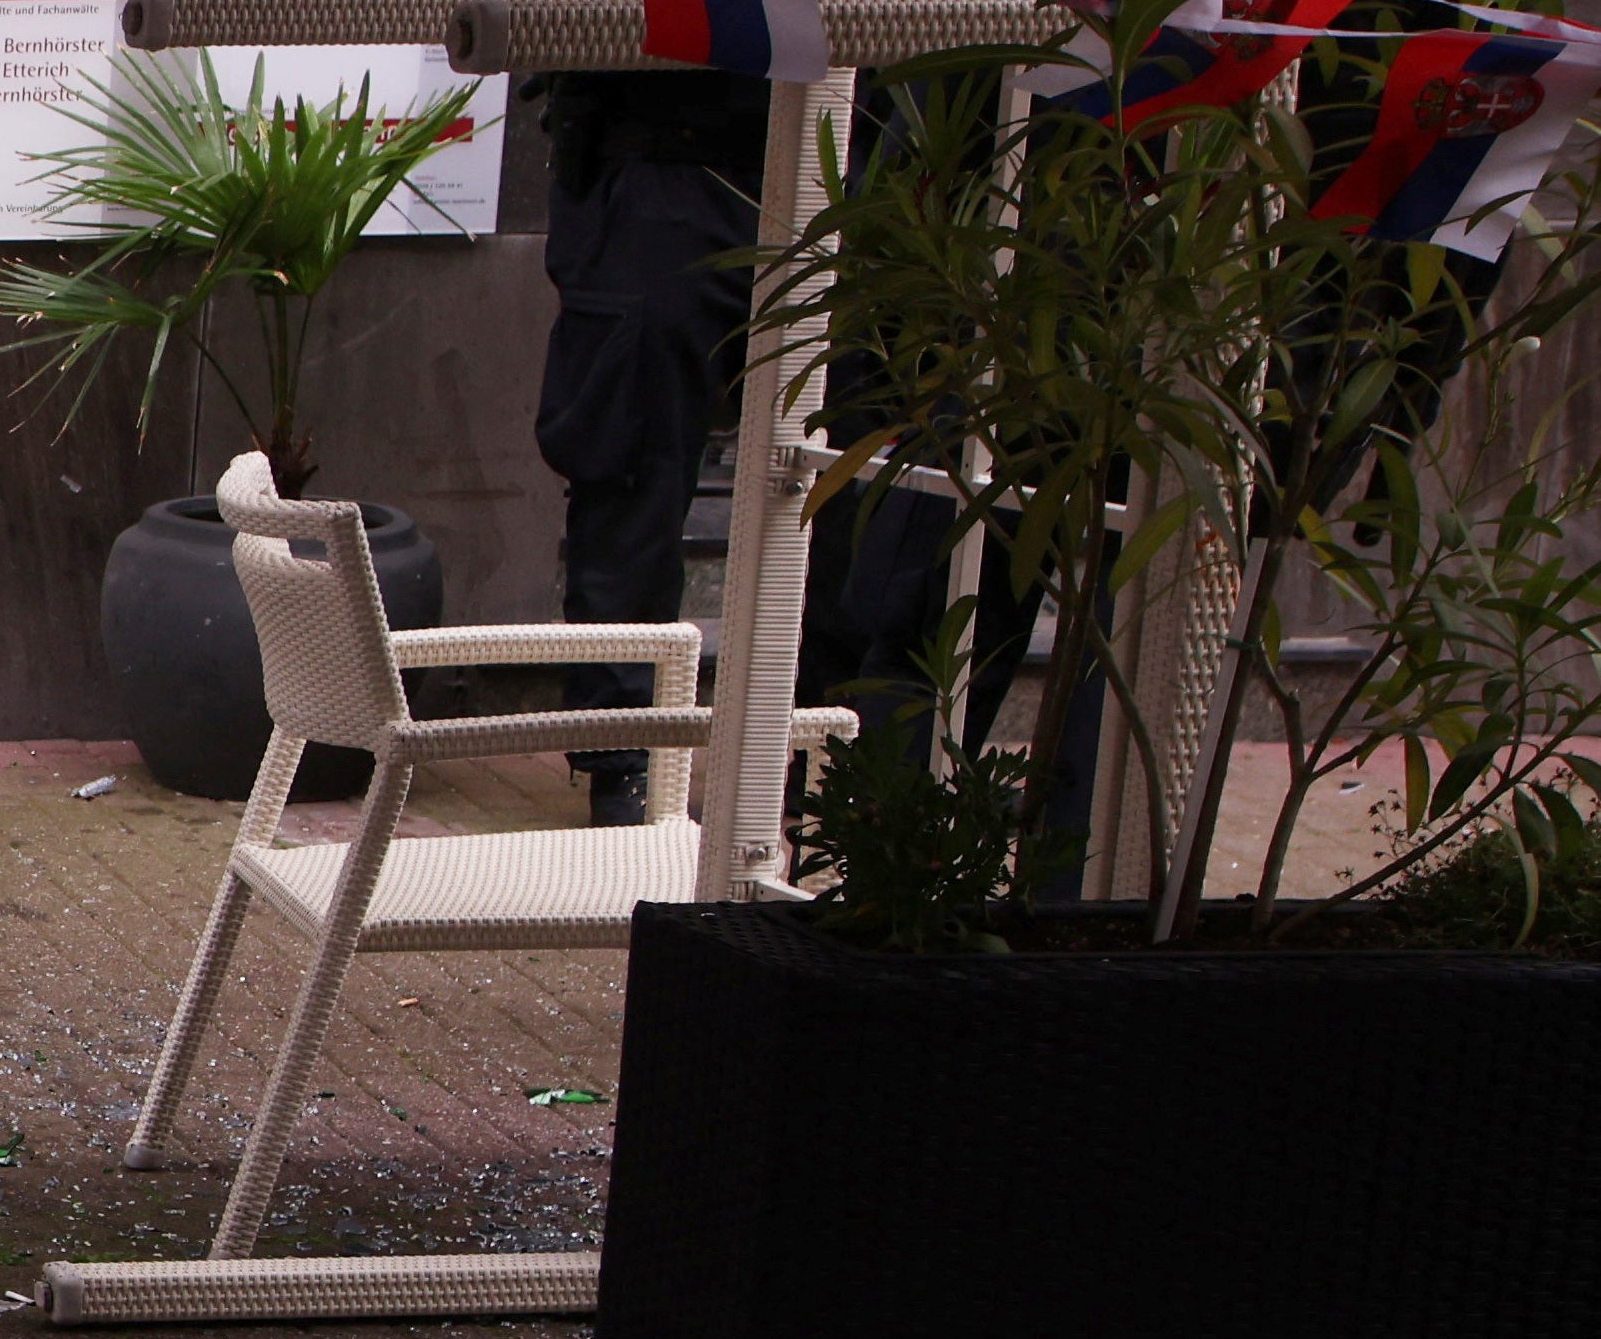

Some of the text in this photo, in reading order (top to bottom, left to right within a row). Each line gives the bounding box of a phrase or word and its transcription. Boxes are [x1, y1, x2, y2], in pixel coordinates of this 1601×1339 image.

[15, 6, 34, 16] und
[38, 5, 99, 15] Fachanwälte
[4, 37, 105, 54] Bernhörster
[3, 62, 69, 78] Etterich
